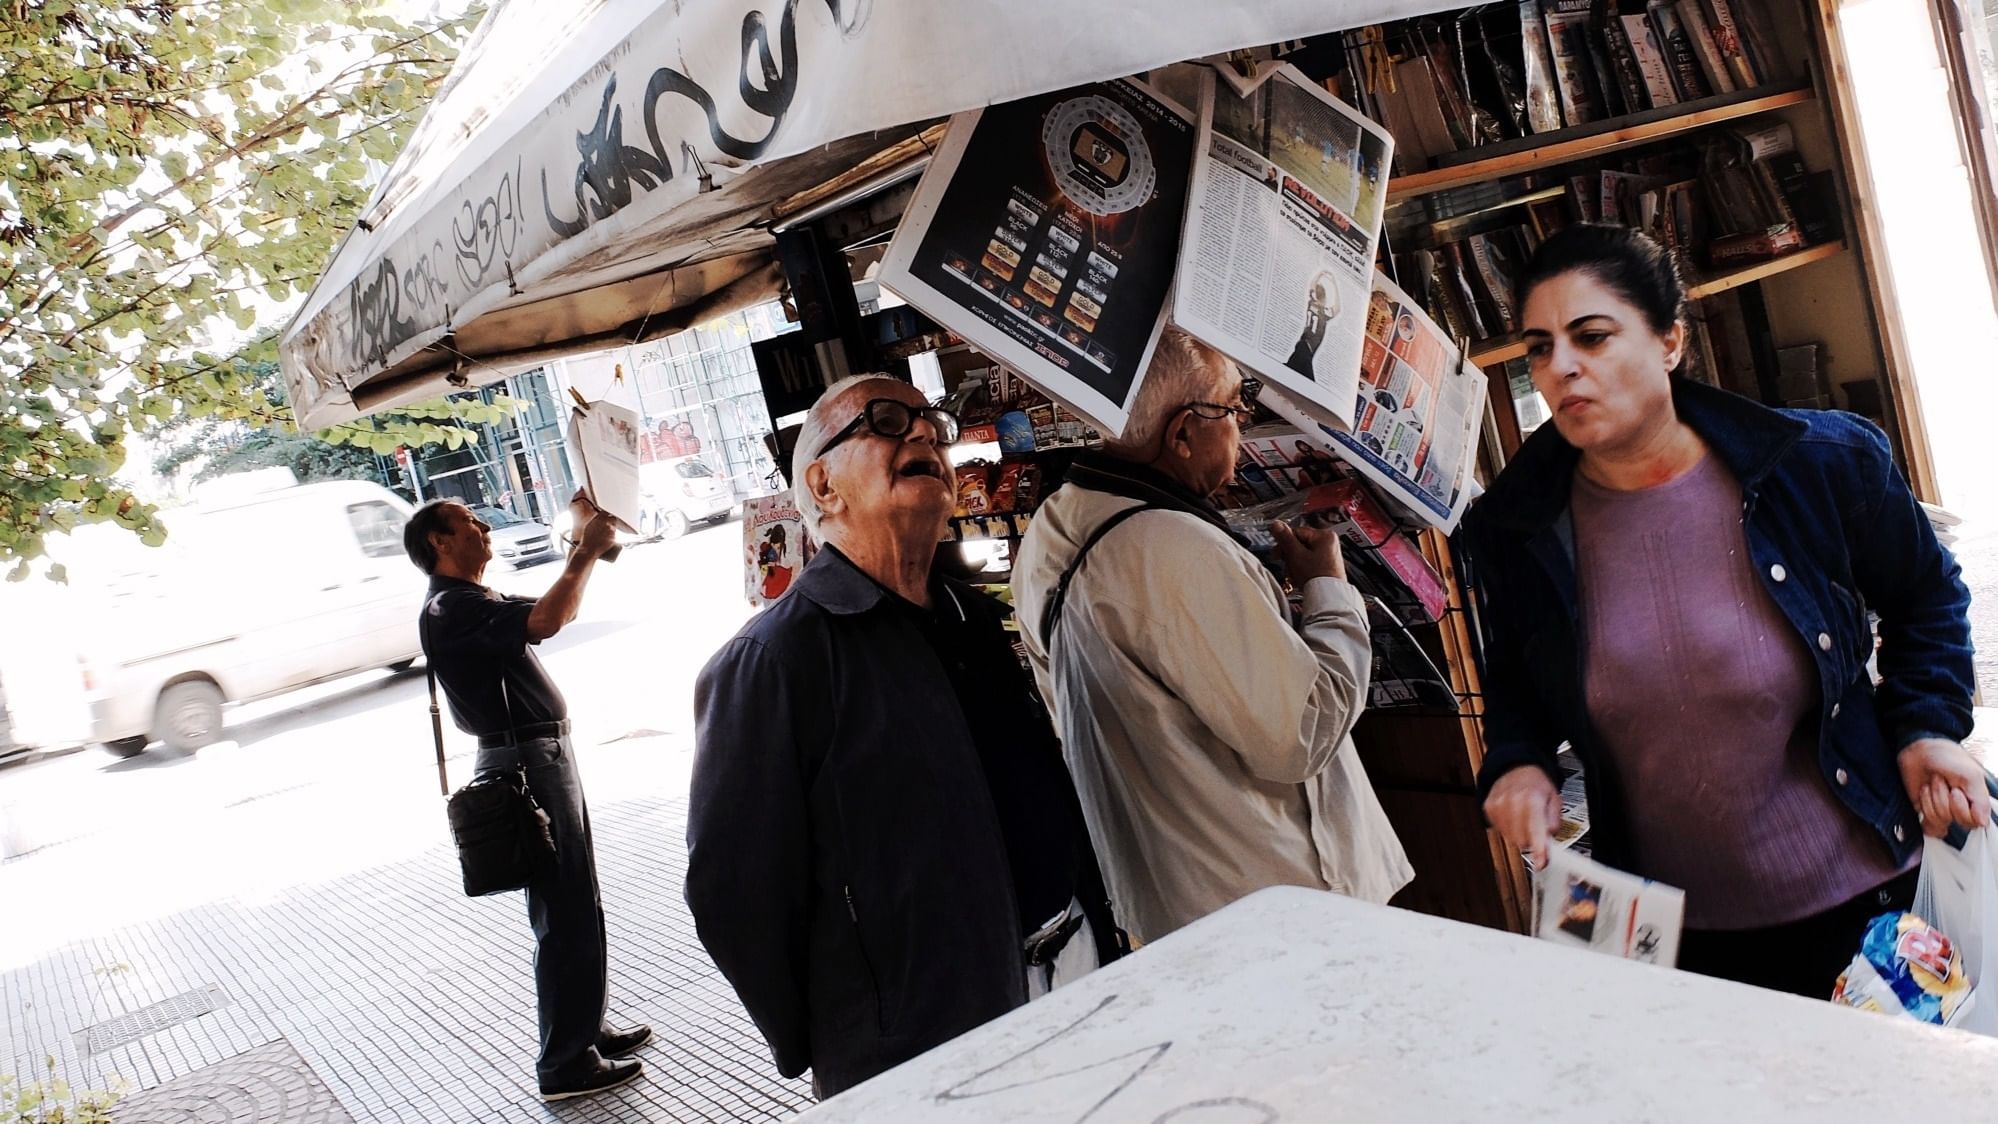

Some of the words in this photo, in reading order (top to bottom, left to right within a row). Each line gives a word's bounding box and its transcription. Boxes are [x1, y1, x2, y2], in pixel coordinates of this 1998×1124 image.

[1145, 101, 1164, 115] 2014
[1211, 139, 1234, 156] Total
[1232, 150, 1265, 172] football
[1007, 215, 1028, 231] BLACK
[995, 244, 1013, 257] GOLD
[1047, 242, 1069, 258] BLACK
[1037, 271, 1055, 284] GOLD
[1087, 268, 1108, 284] BLACK
